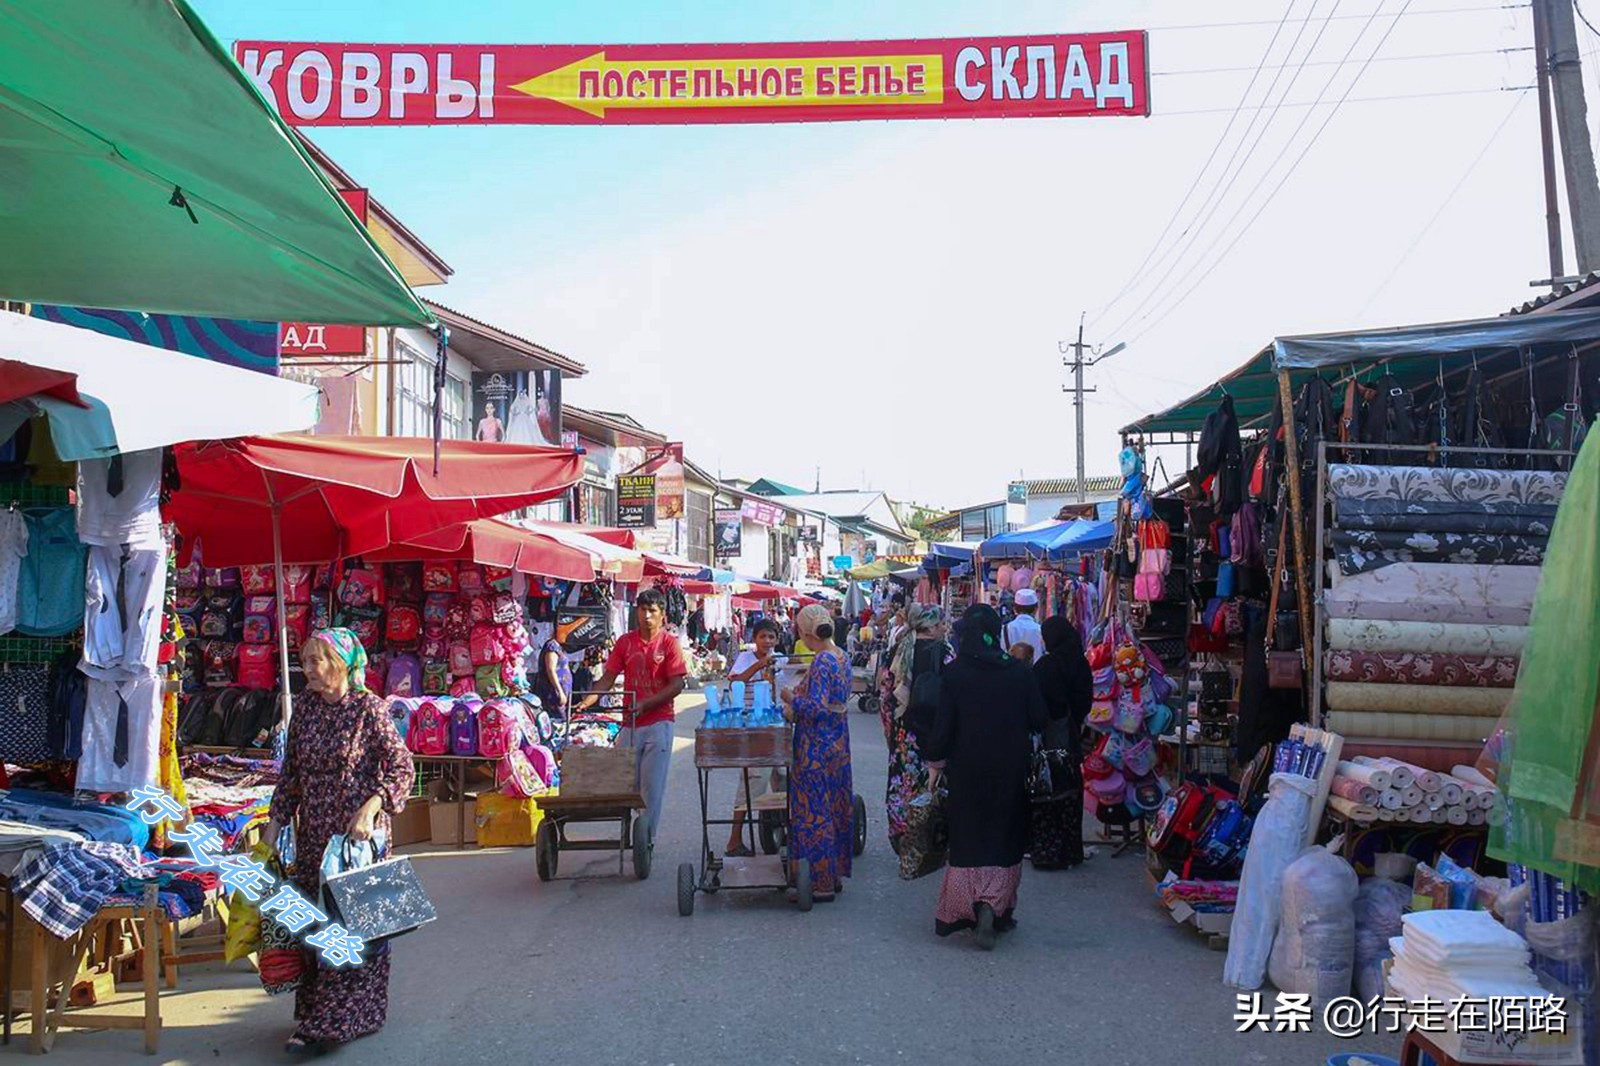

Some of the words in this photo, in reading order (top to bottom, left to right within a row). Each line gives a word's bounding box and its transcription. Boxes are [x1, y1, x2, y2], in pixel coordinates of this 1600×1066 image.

[243, 48, 496, 119] КОВРЫ
[577, 66, 805, 100] ПОСТЕЛЬНОЕ
[815, 61, 926, 98] БЕЛЬЕ
[953, 41, 1135, 110] СКЛАД
[619, 476, 654, 486] ТКАНИ
[573, 620, 597, 639] NIKE
